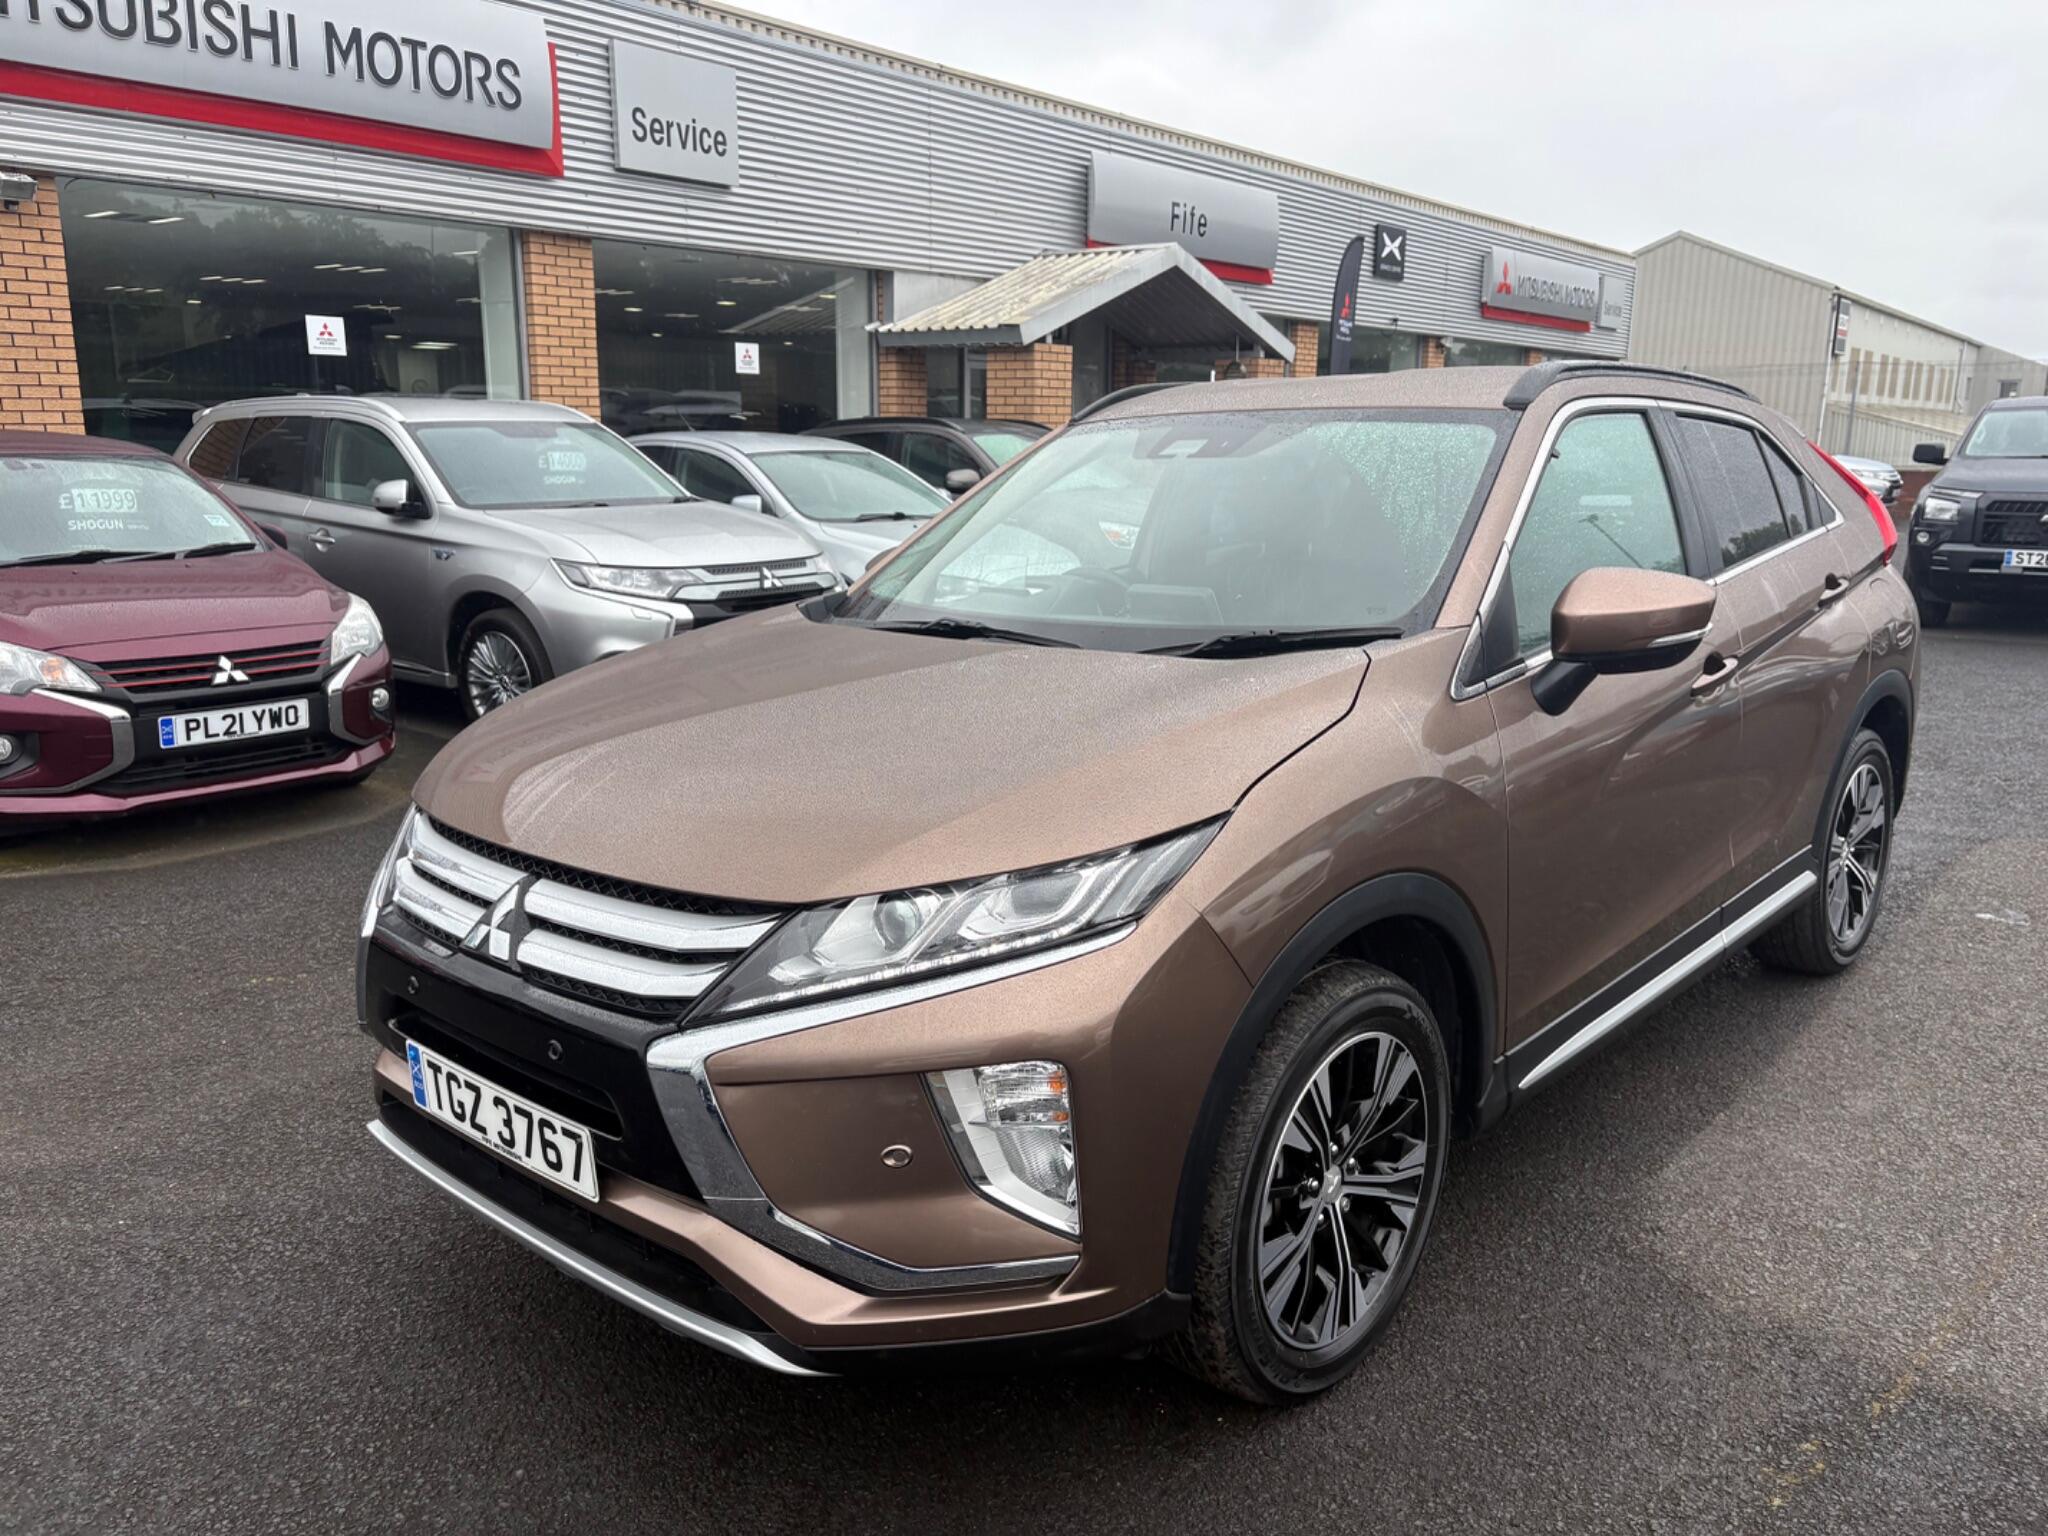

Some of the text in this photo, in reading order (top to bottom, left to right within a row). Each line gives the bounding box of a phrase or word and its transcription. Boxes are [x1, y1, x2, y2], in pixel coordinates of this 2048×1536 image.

[0, 0, 522, 110] SUBISHI MOTORS
[632, 106, 727, 157] Service
[1170, 201, 1207, 238] Fife
[1518, 275, 1563, 303] MITSUBISHI
[68, 518, 124, 531] SHOGUN
[184, 704, 299, 742] PL21 YWO
[427, 1058, 583, 1183] TGZ 3767
